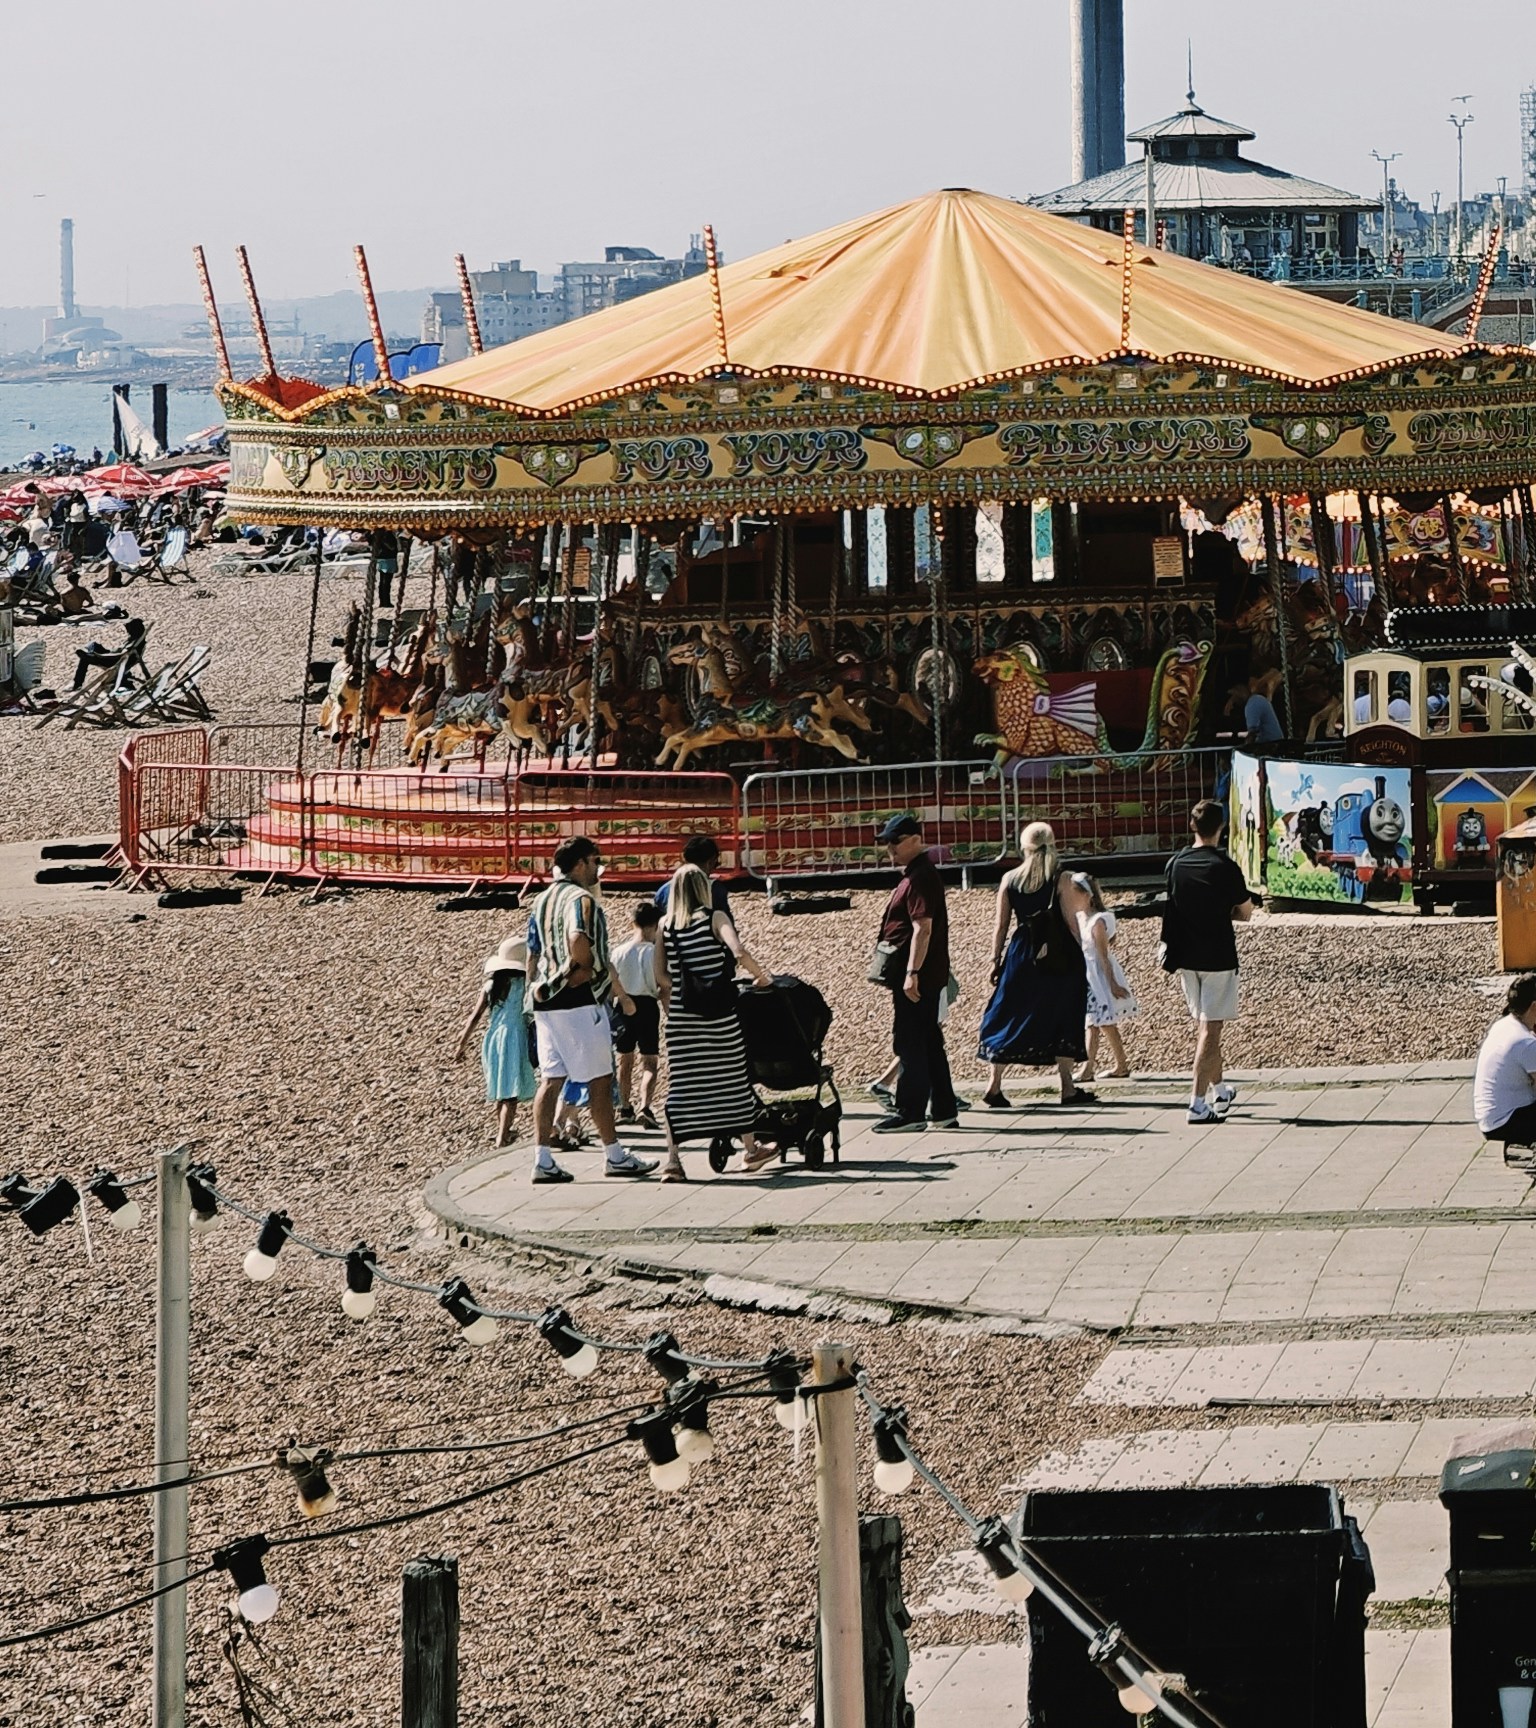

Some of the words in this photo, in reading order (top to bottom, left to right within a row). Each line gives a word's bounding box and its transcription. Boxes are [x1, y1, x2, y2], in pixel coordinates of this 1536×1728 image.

[323, 447, 497, 489] PRESENTS
[610, 437, 713, 483] FOR
[718, 428, 868, 477] YOUR
[997, 417, 1252, 465] PLEASURE
